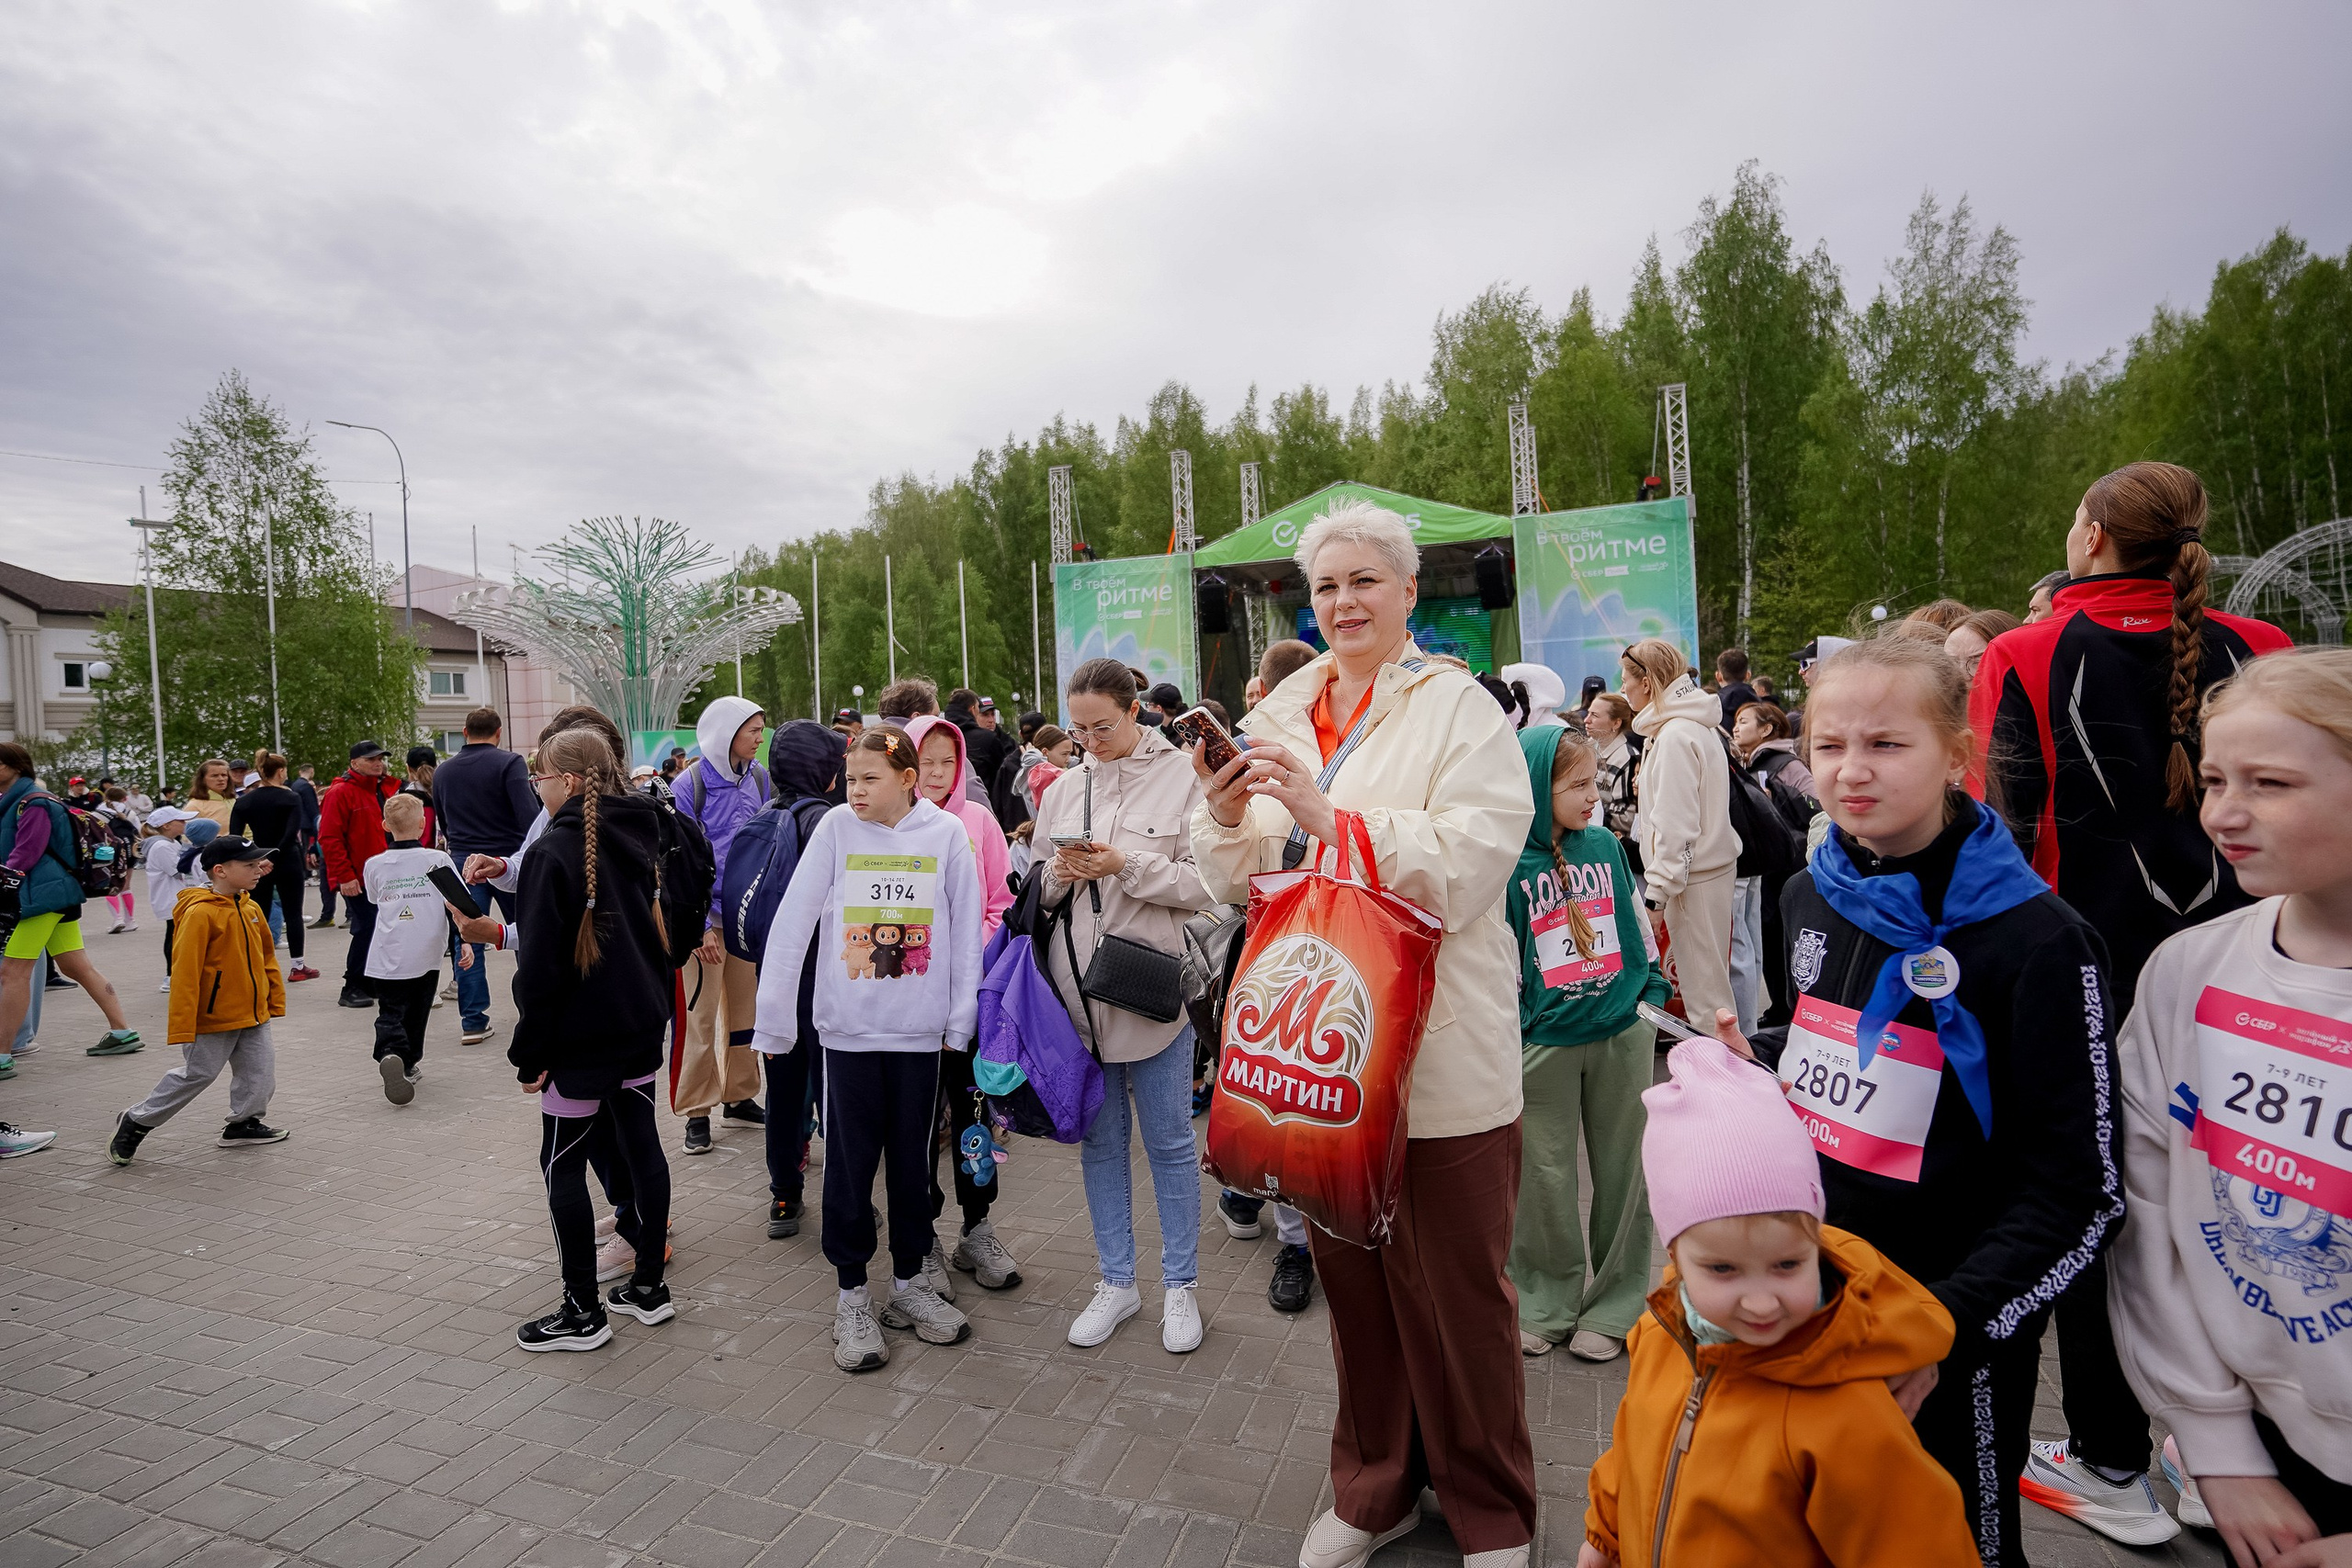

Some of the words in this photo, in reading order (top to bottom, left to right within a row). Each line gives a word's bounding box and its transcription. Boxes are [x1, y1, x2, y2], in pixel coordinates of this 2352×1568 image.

[1536, 531, 1548, 546] В
[1552, 528, 1603, 544] твоём
[1568, 535, 1668, 569] ритме
[1073, 580, 1082, 591] В
[1086, 576, 1126, 590] твоём
[1097, 584, 1172, 611] ритме
[2120, 616, 2153, 627] Rex
[870, 884, 915, 901] 3194
[1817, 1049, 1831, 1060] 7-9
[1832, 1055, 1851, 1068] ЛЕТ
[1226, 1057, 1344, 1113] МАРТИН
[1793, 1057, 1878, 1114] 2807
[2267, 1063, 2290, 1078] 7-9
[2294, 1072, 2329, 1089] ЛЕТ
[582, 1324, 594, 1333] FILA
